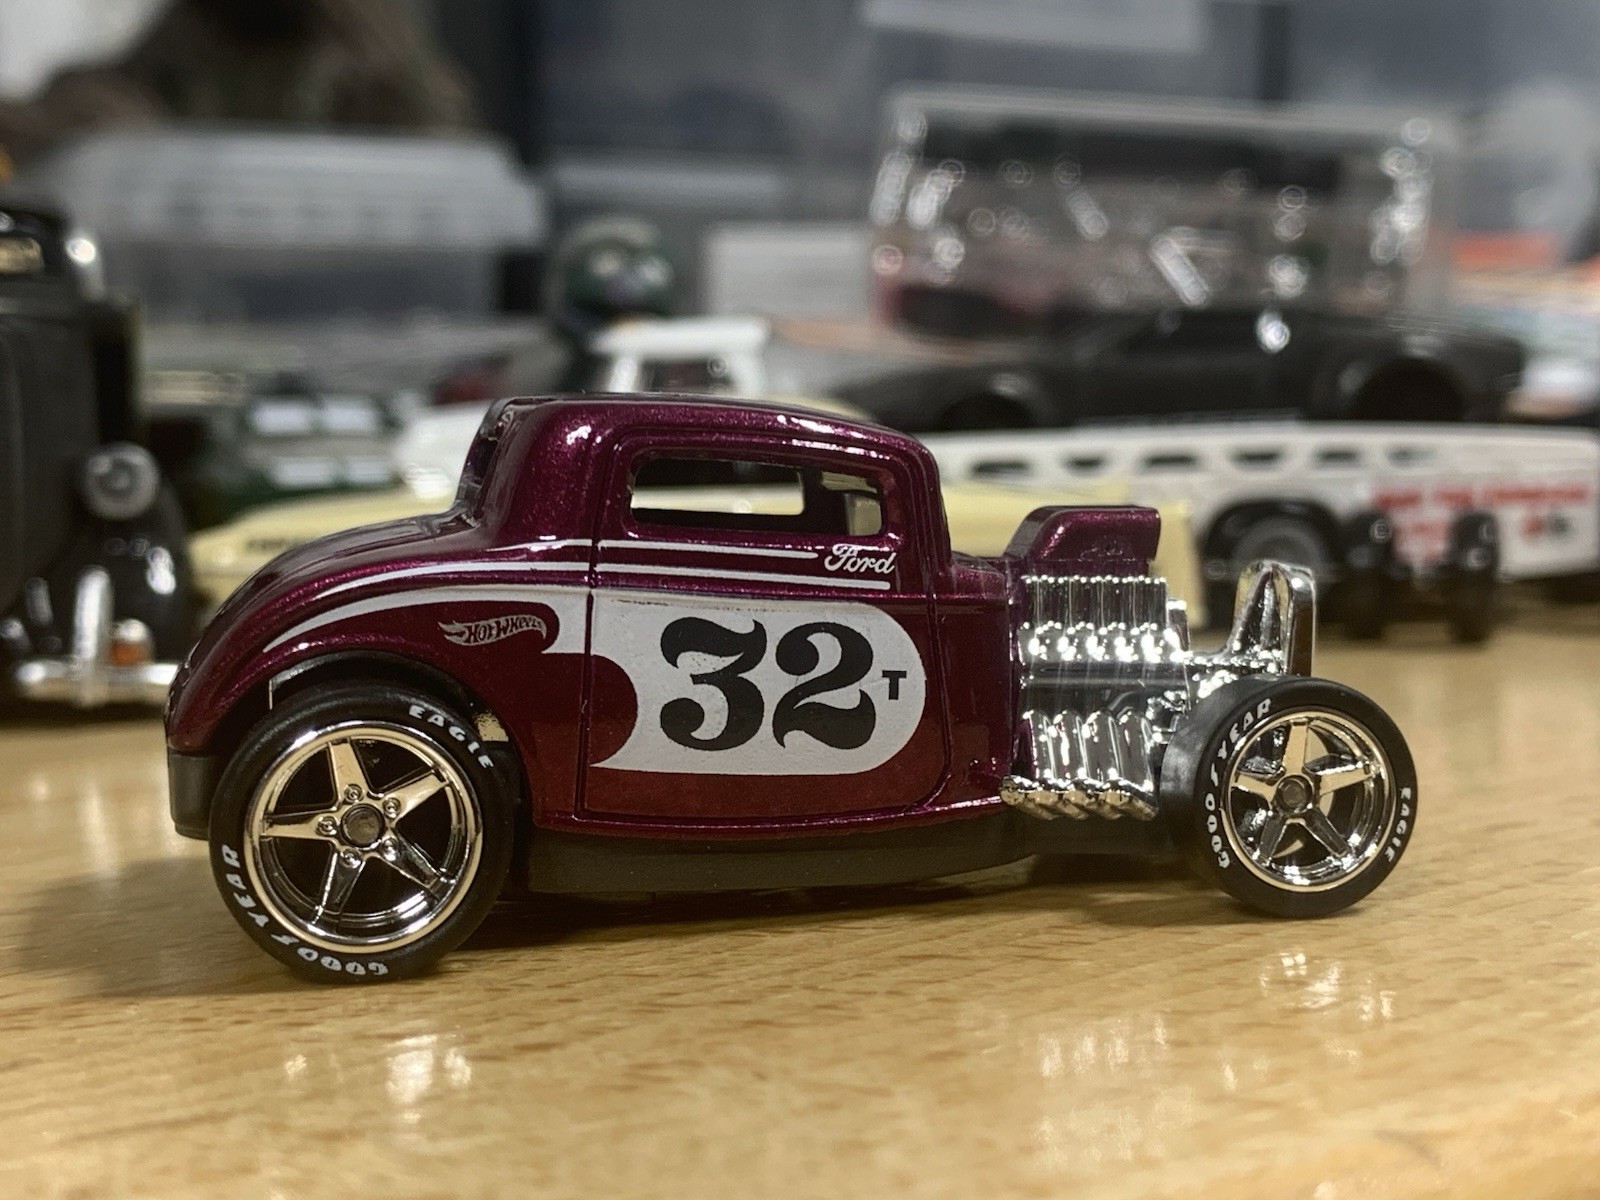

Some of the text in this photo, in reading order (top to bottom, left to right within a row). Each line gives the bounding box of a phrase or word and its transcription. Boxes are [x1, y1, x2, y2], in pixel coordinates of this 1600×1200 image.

[824, 543, 897, 574] Ford
[660, 616, 877, 751] 32
[408, 704, 494, 768] EAGLE
[1385, 787, 1411, 862] EAGLE
